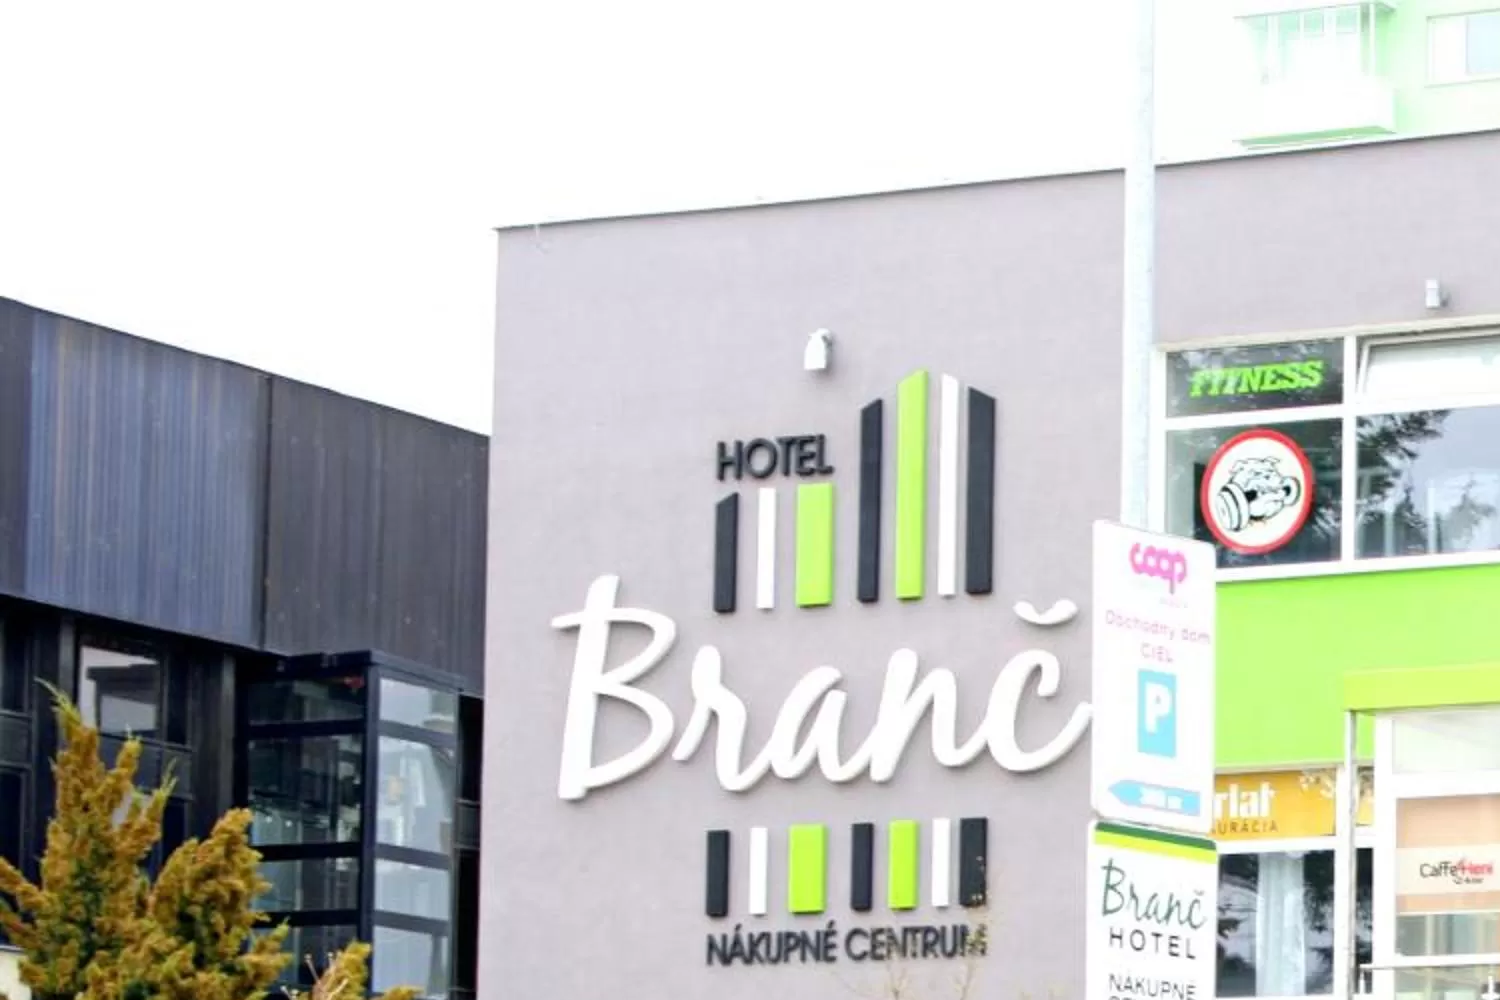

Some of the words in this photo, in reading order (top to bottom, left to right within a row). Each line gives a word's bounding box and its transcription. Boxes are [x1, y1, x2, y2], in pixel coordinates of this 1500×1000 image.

[1190, 360, 1324, 397] FITNESS
[717, 435, 834, 480] HOTEL
[1129, 542, 1187, 594] coop
[552, 575, 1093, 800] Branč
[1145, 681, 1172, 734] P
[1101, 857, 1207, 930] Branč
[707, 921, 837, 966] NÁKUPNÉ
[845, 924, 987, 962] CENTRUM
[1109, 927, 1196, 959] HOTEL
